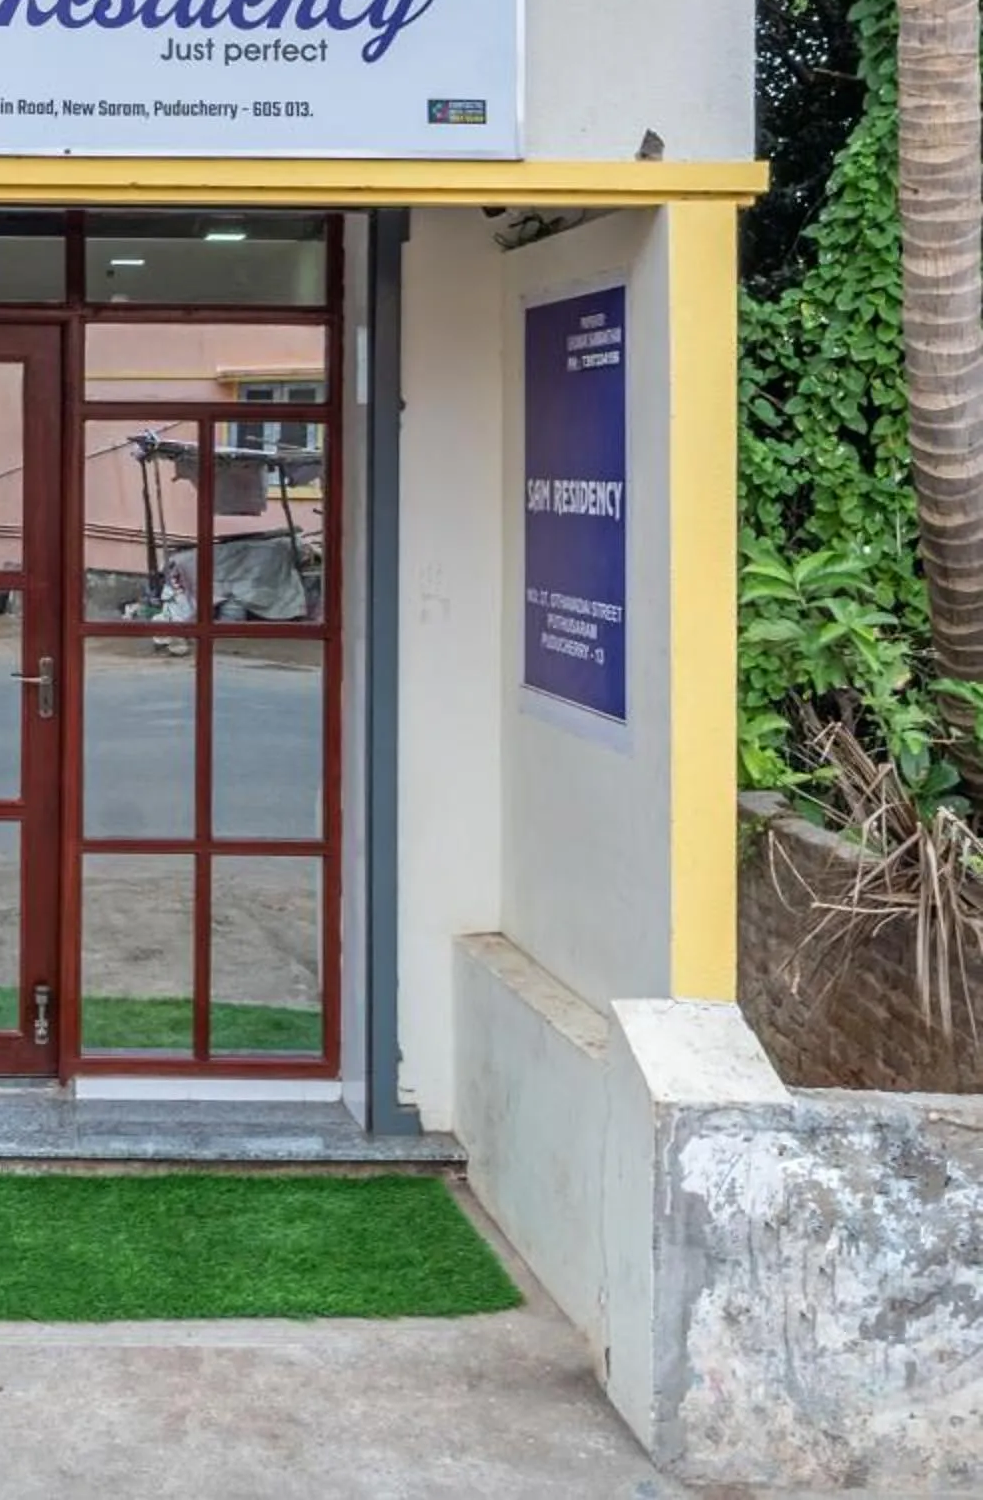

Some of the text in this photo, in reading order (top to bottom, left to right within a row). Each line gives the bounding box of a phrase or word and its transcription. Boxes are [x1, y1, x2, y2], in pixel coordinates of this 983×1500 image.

[160, 37, 329, 67] Just perfect
[17, 98, 59, 118] Road,
[62, 99, 95, 117] New
[153, 99, 239, 121] Puducherry
[252, 100, 282, 118] 605
[284, 100, 314, 118] 013.
[527, 478, 623, 521] SAM RESIDENCY
